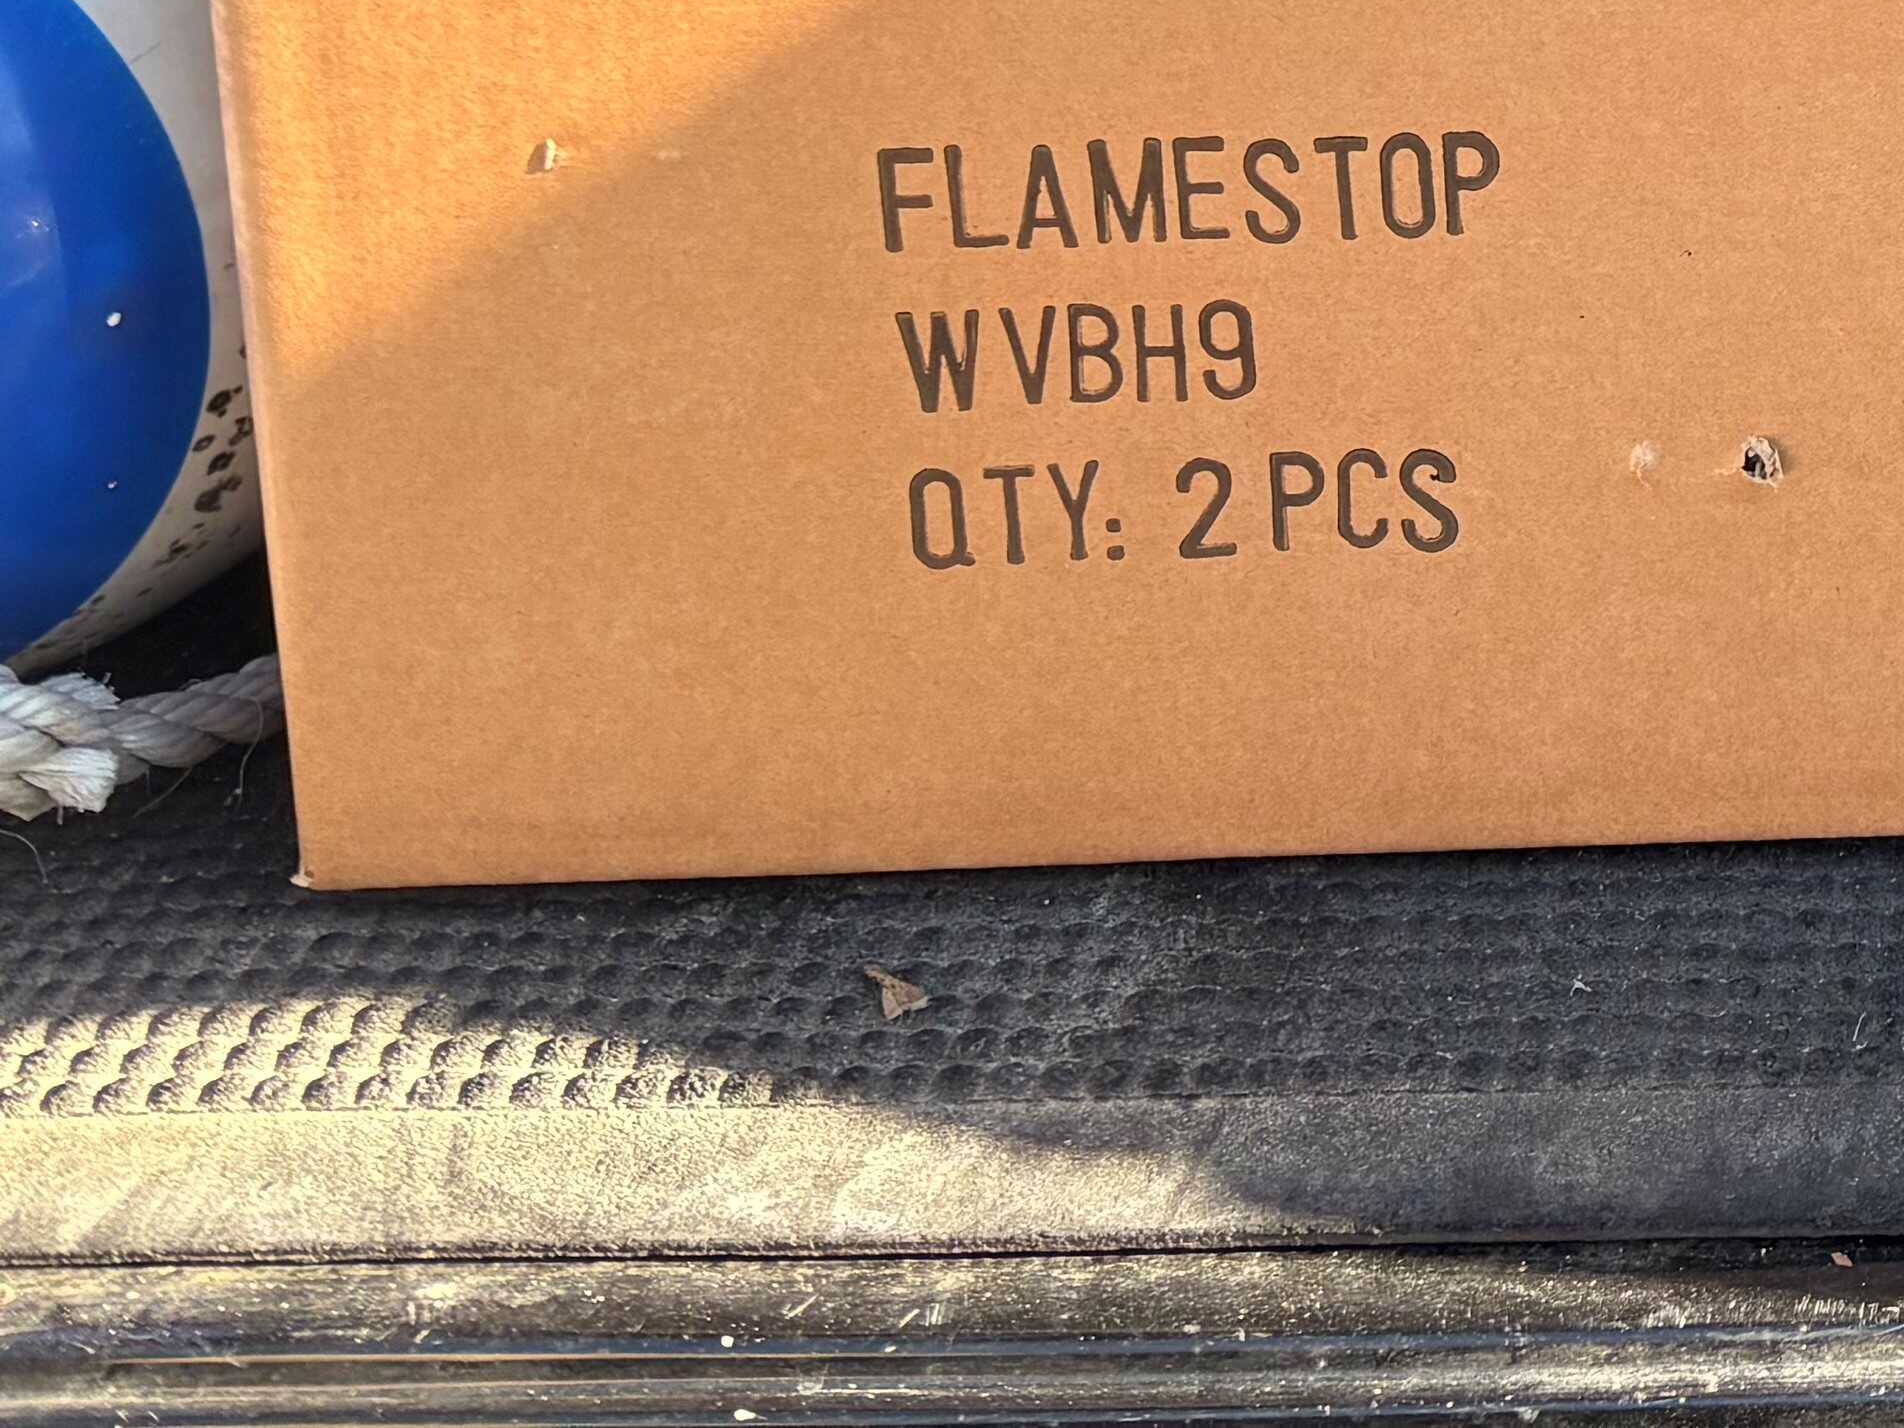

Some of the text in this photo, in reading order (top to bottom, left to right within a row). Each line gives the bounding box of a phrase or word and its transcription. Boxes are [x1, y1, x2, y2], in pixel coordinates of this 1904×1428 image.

[877, 131, 1500, 253] FLAMESTOP
[895, 299, 1256, 413] WVBH9
[909, 448, 1459, 569] QTY: 2 PCS
